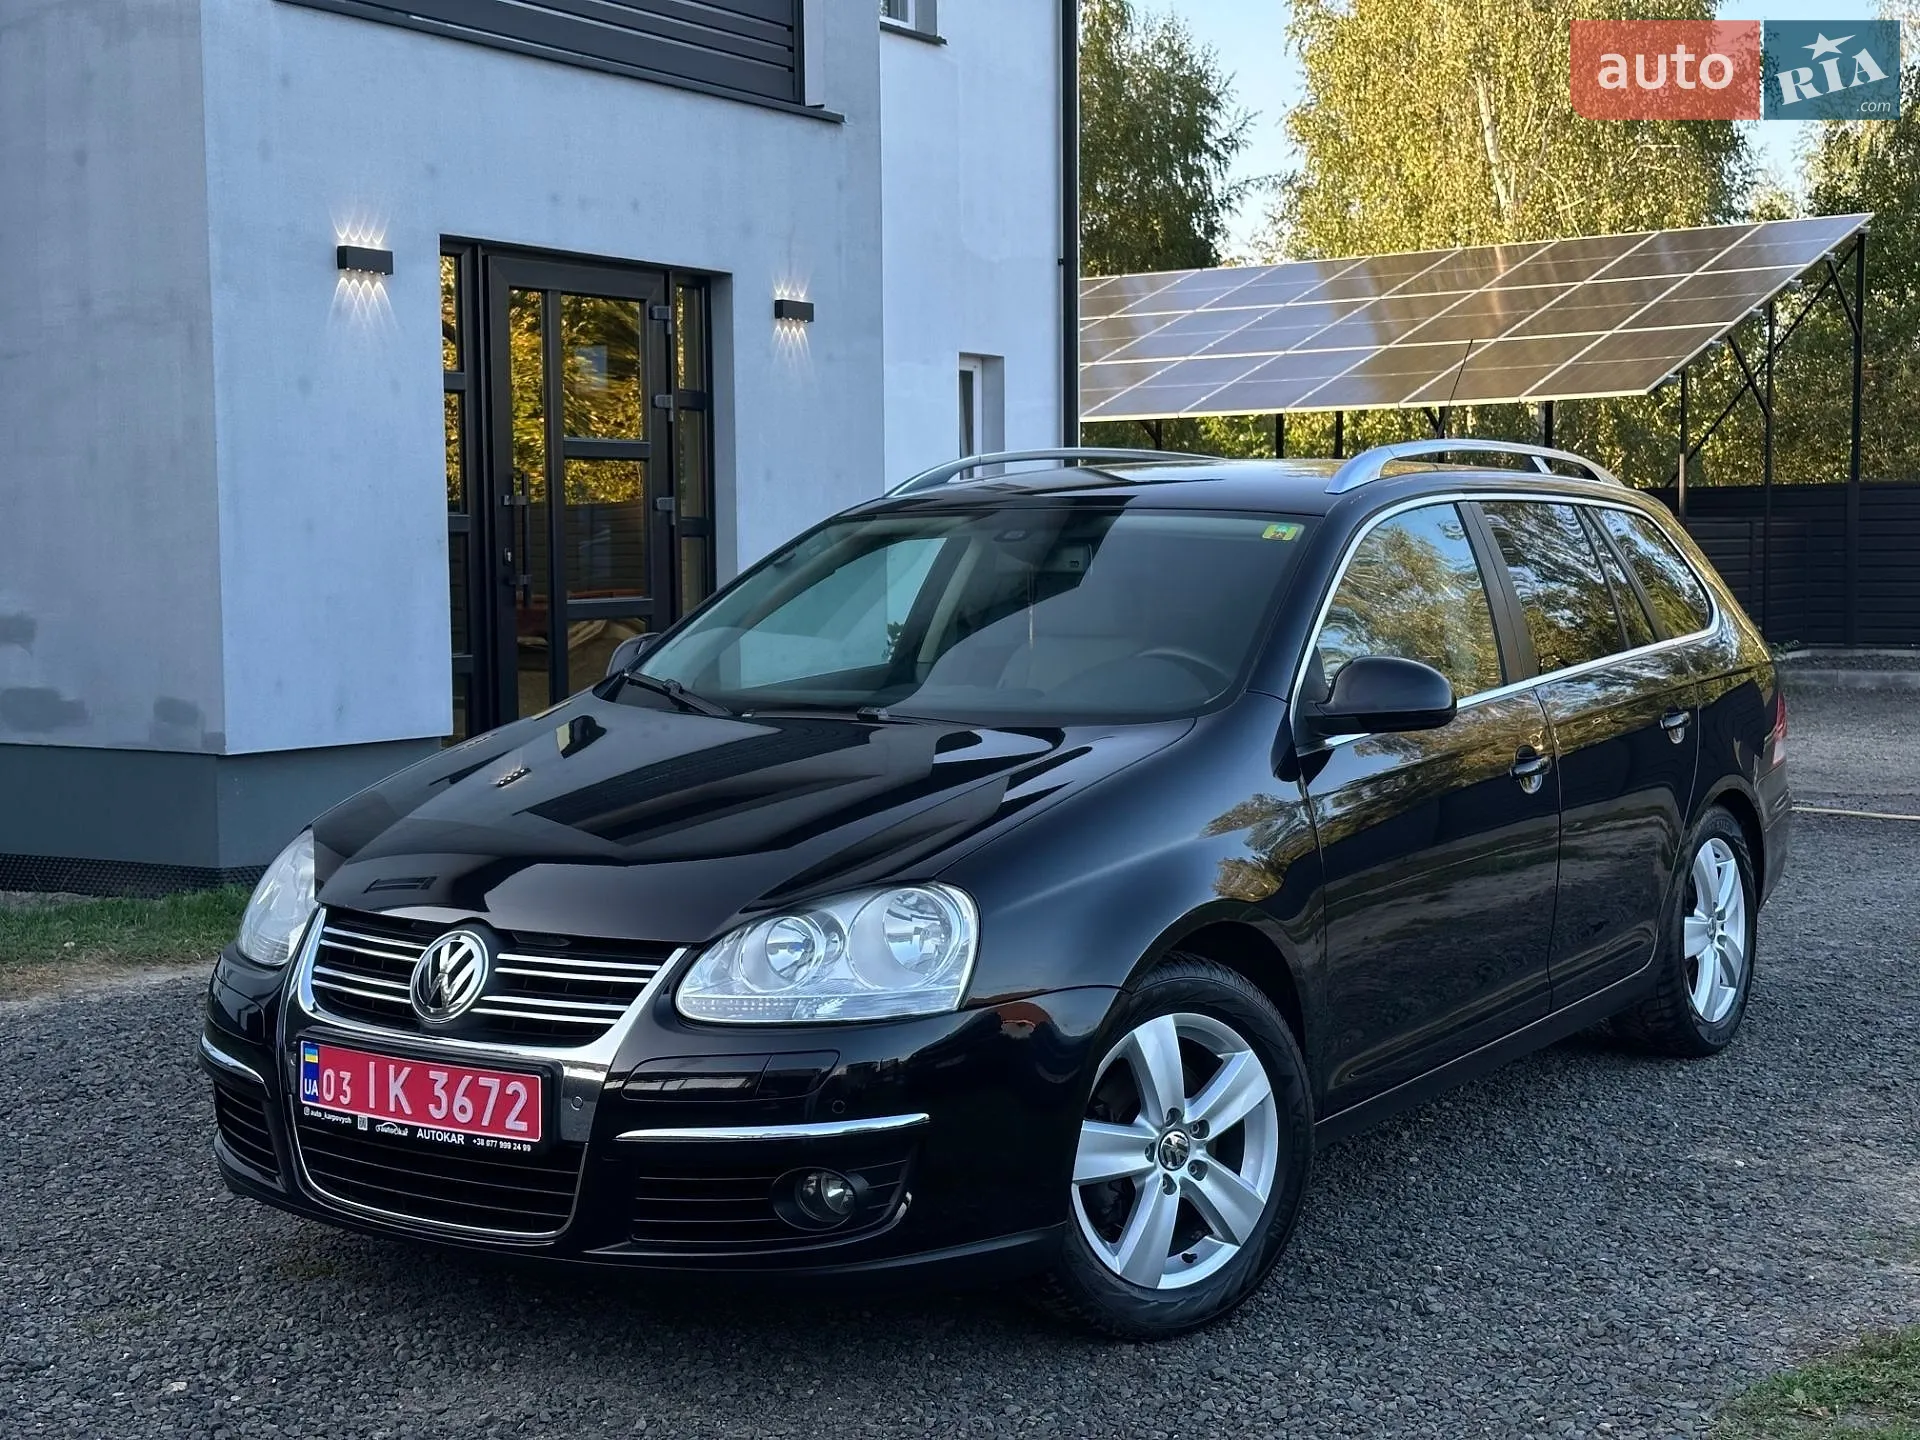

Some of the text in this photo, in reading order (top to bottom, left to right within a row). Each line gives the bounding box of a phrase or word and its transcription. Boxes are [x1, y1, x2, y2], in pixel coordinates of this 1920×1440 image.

[304, 1078, 319, 1097] UA
[322, 1061, 529, 1132] 03 IK 3672
[416, 1128, 465, 1145] AUTOKAR
